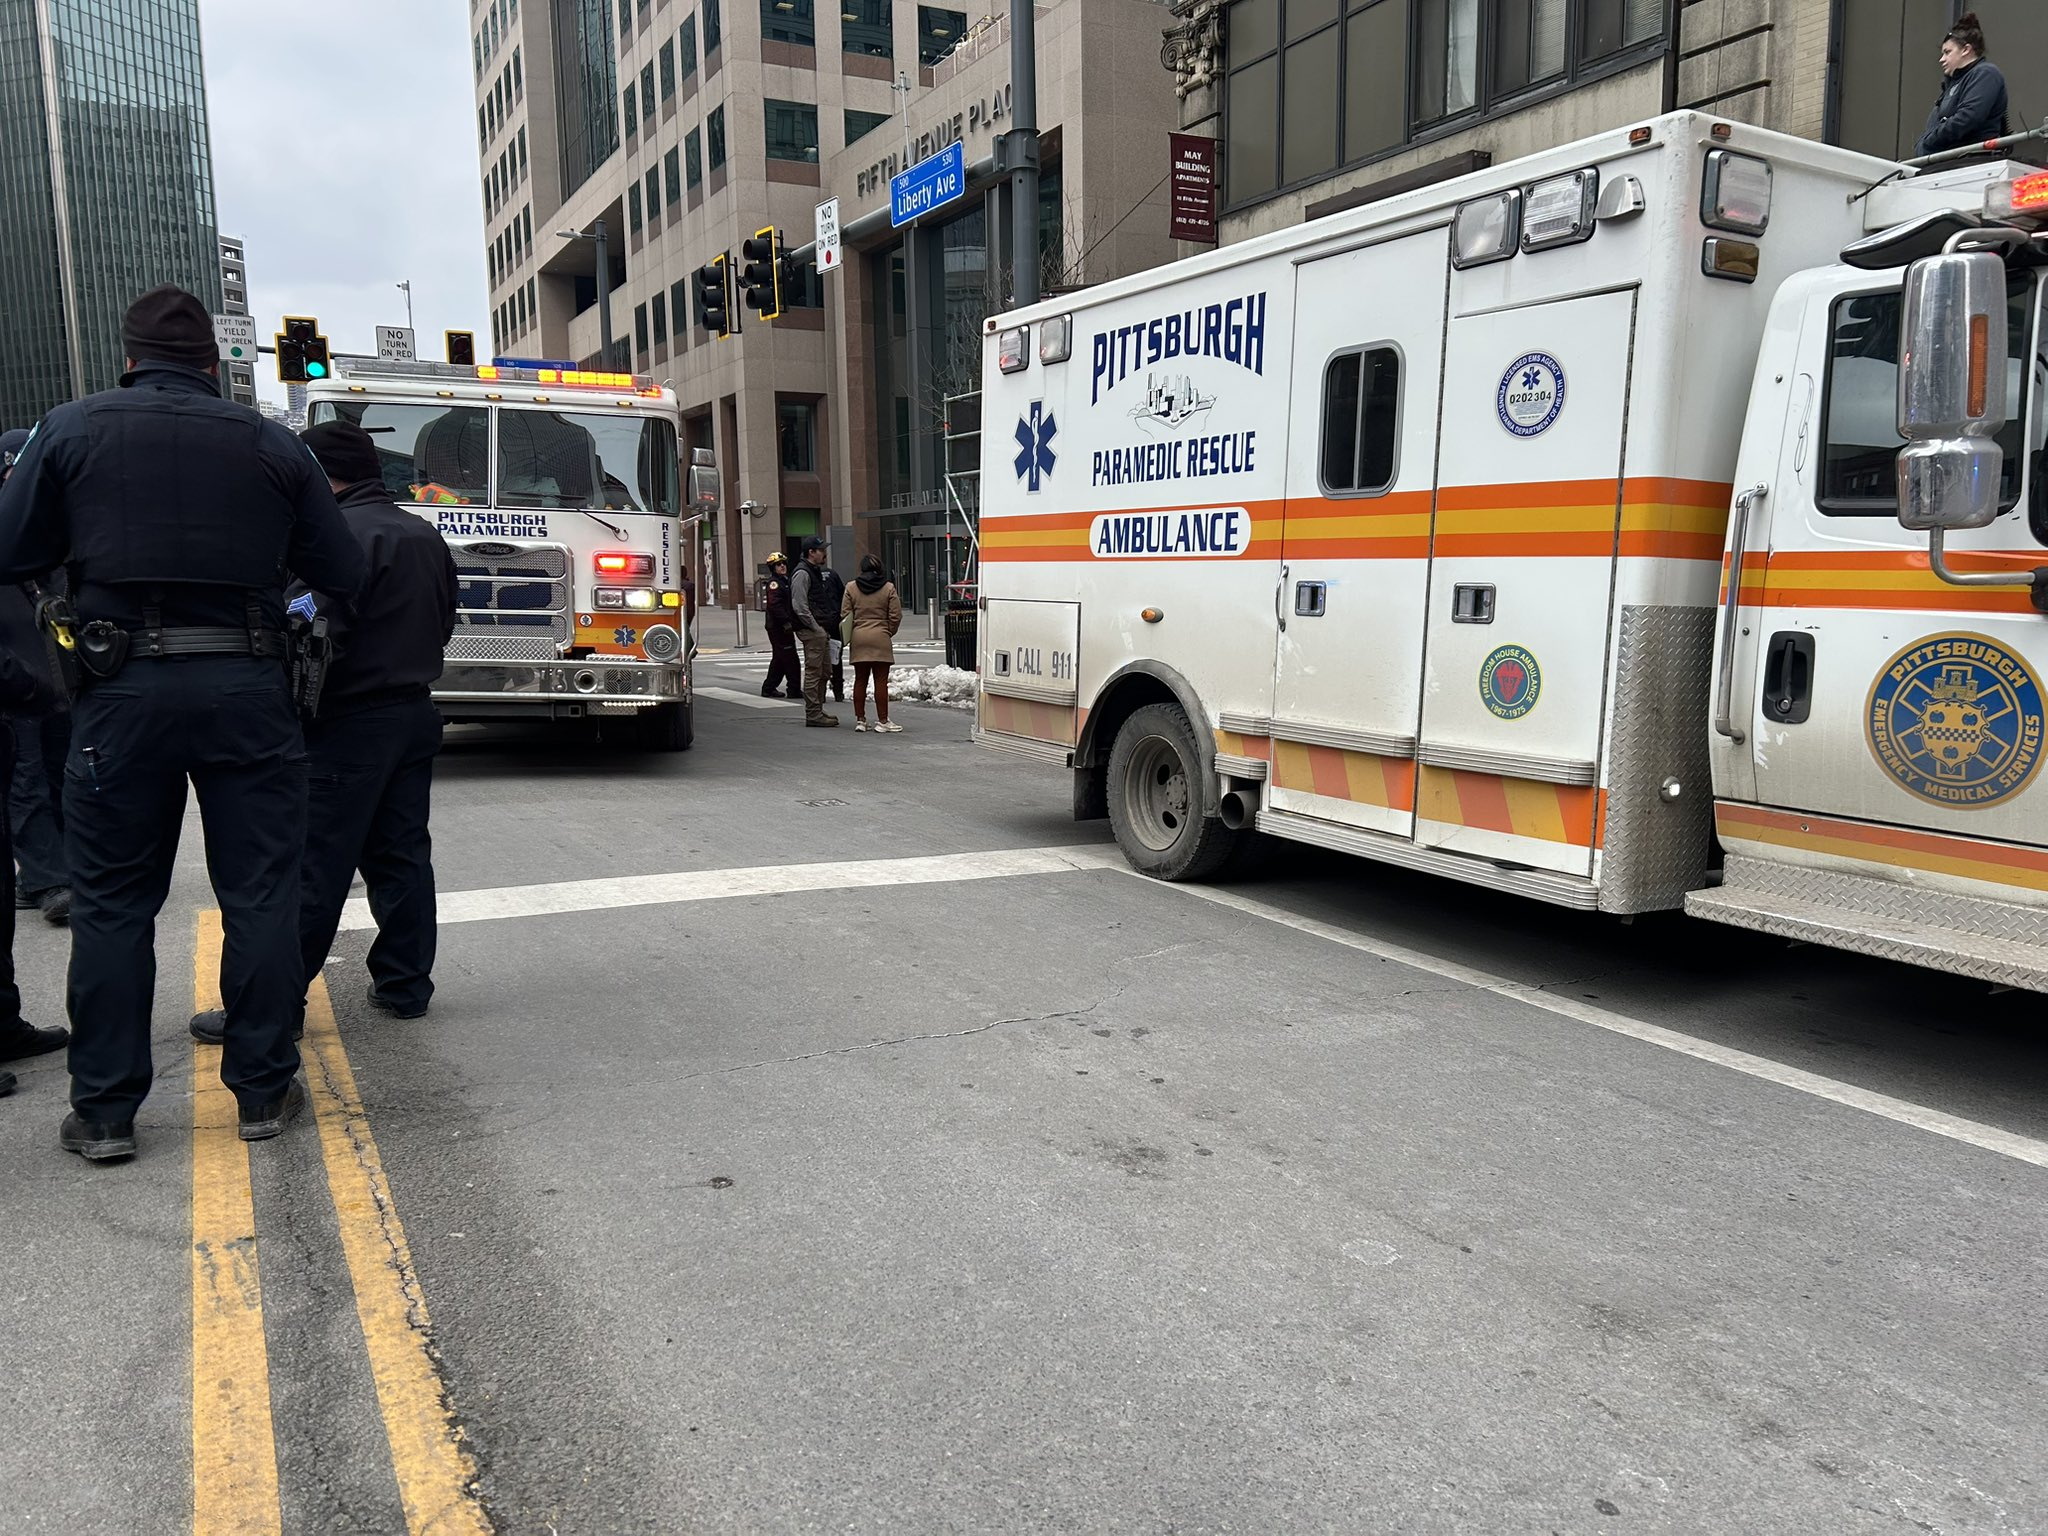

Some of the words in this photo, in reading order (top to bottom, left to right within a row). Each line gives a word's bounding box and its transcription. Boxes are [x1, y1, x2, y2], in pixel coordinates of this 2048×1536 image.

[857, 152, 897, 197] FIFTH
[902, 112, 962, 172] AVENUE
[970, 84, 1012, 132] PLAC
[1184, 150, 1202, 160] MAY
[1176, 161, 1210, 174] BUILDING
[900, 176, 910, 190] 500
[1176, 174, 1210, 184] APARTMENTS
[898, 184, 932, 216] Liberty
[936, 173, 956, 199] Ave
[822, 206, 832, 220] NO
[821, 220, 834, 235] TURN
[819, 239, 825, 250] ON
[827, 234, 837, 247] RED
[223, 328, 246, 336] YIELD
[387, 331, 403, 339] NO
[1091, 292, 1266, 407] PITTSBURGH
[1503, 358, 1528, 384] LICENSED
[1528, 354, 1540, 362] EMS
[1540, 356, 1560, 376] AGENCY
[1510, 391, 1551, 404] 0202304
[1498, 386, 1514, 430] PENNSYLVANIA
[1514, 416, 1551, 435] DEPARTMENT
[1550, 408, 1558, 418] OF
[1555, 379, 1564, 408] HEALTH
[1092, 440, 1182, 487] PARAMEDIC
[1187, 431, 1256, 478] RESCUE
[438, 511, 546, 526] PITTSBURGH
[437, 524, 548, 537] PARAMEDICS
[1097, 512, 1239, 554] AMBULANCE
[1016, 647, 1042, 676] CALL
[1890, 642, 2028, 688] PITTSBURGH
[1482, 658, 1496, 698] FREEDOM
[1495, 649, 1520, 660] HOUSE
[1520, 653, 1537, 703] AMBULANCE
[1873, 698, 1918, 782] EMERGENCY
[1924, 782, 1998, 800] MEDICAL
[1999, 714, 2040, 788] SERVICES
